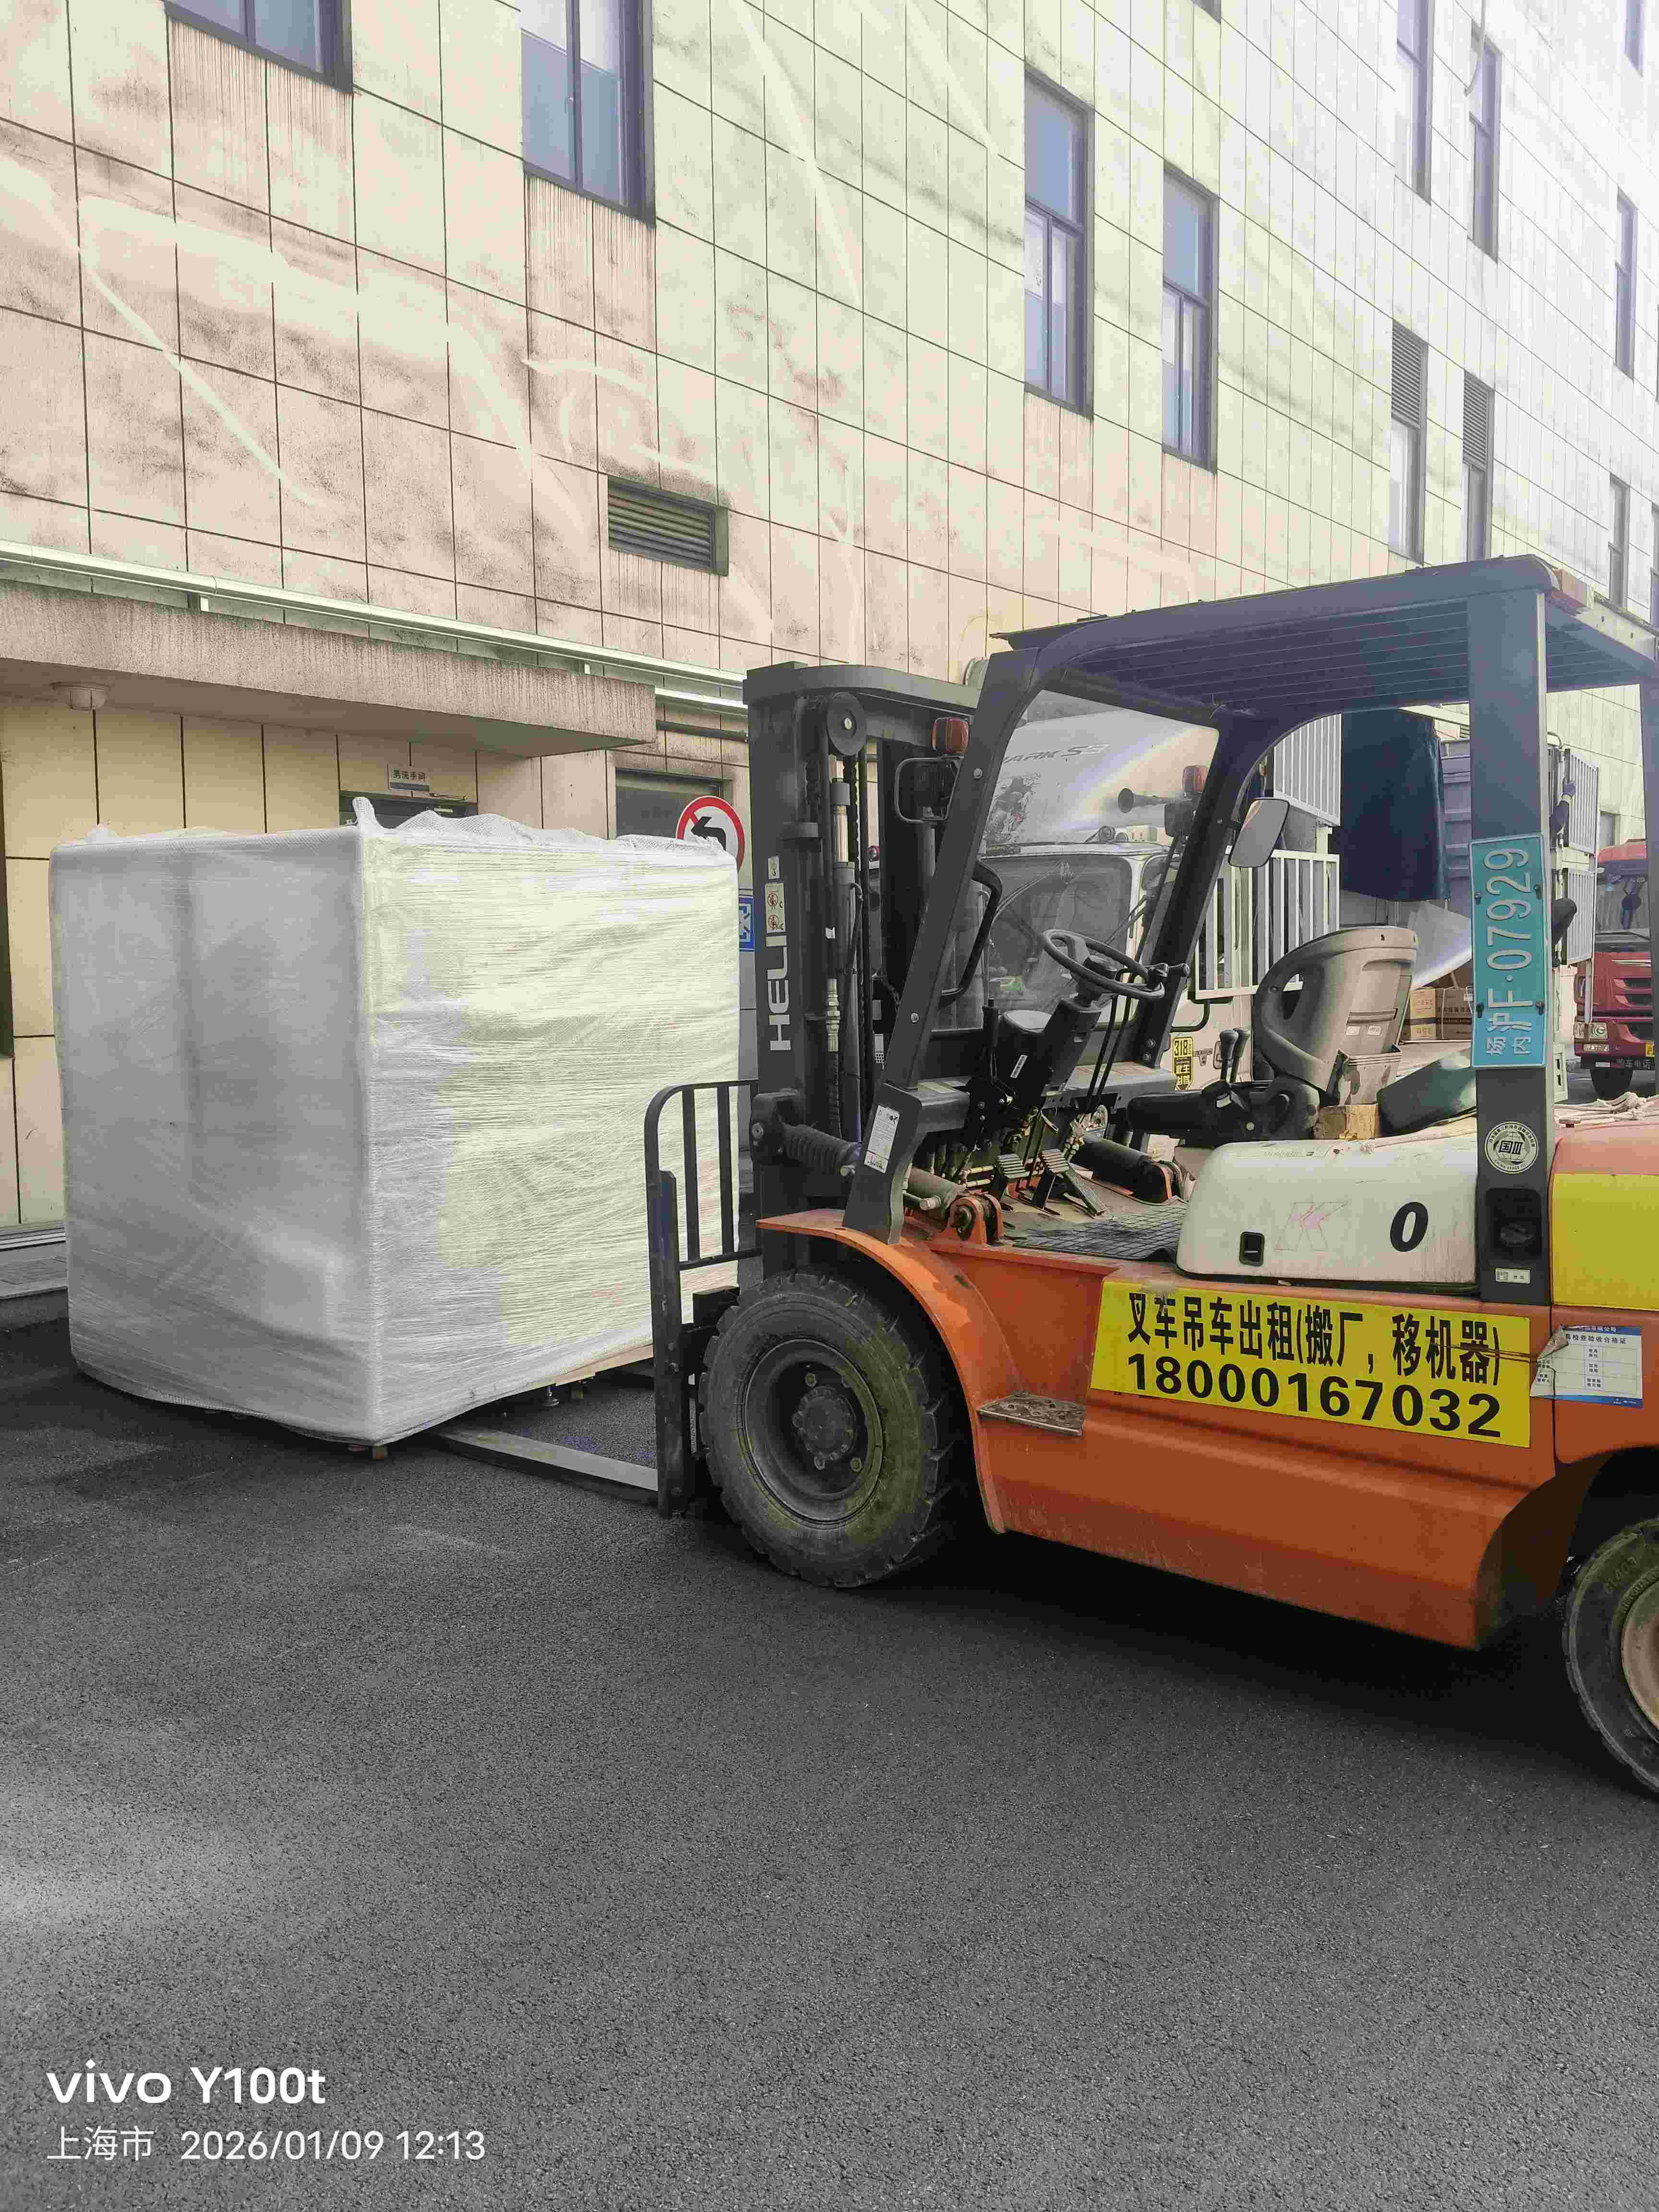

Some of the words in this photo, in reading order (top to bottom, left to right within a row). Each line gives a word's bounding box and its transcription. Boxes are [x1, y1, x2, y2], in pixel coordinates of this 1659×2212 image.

[766, 934, 791, 1051] HELI
[1174, 1040, 1188, 1056] 318
[1390, 1202, 1429, 1252] 0
[1128, 1353, 1502, 1438] 18000167032
